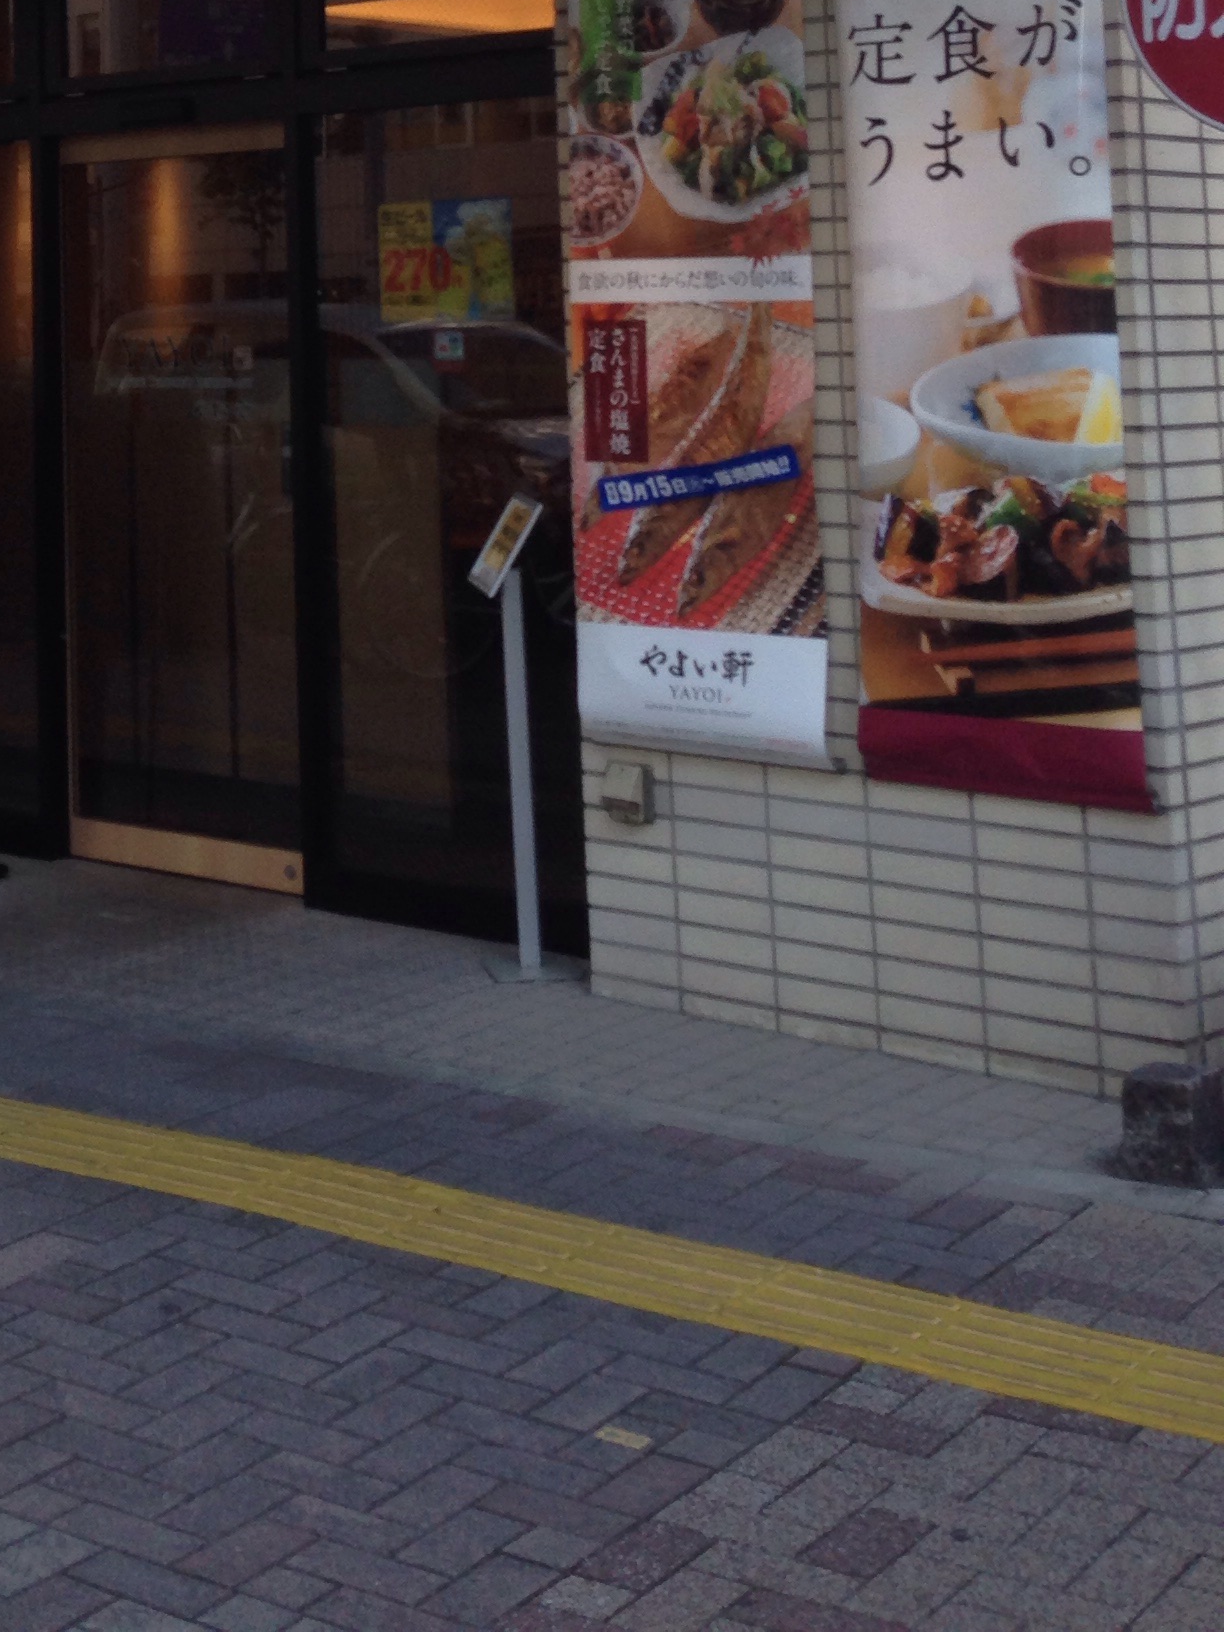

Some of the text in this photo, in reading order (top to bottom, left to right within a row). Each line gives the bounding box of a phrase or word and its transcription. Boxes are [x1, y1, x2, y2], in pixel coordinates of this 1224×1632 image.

[860, 110, 1092, 187] うまい。
[640, 644, 755, 687] やよい軒
[668, 684, 723, 705] YAYOI
